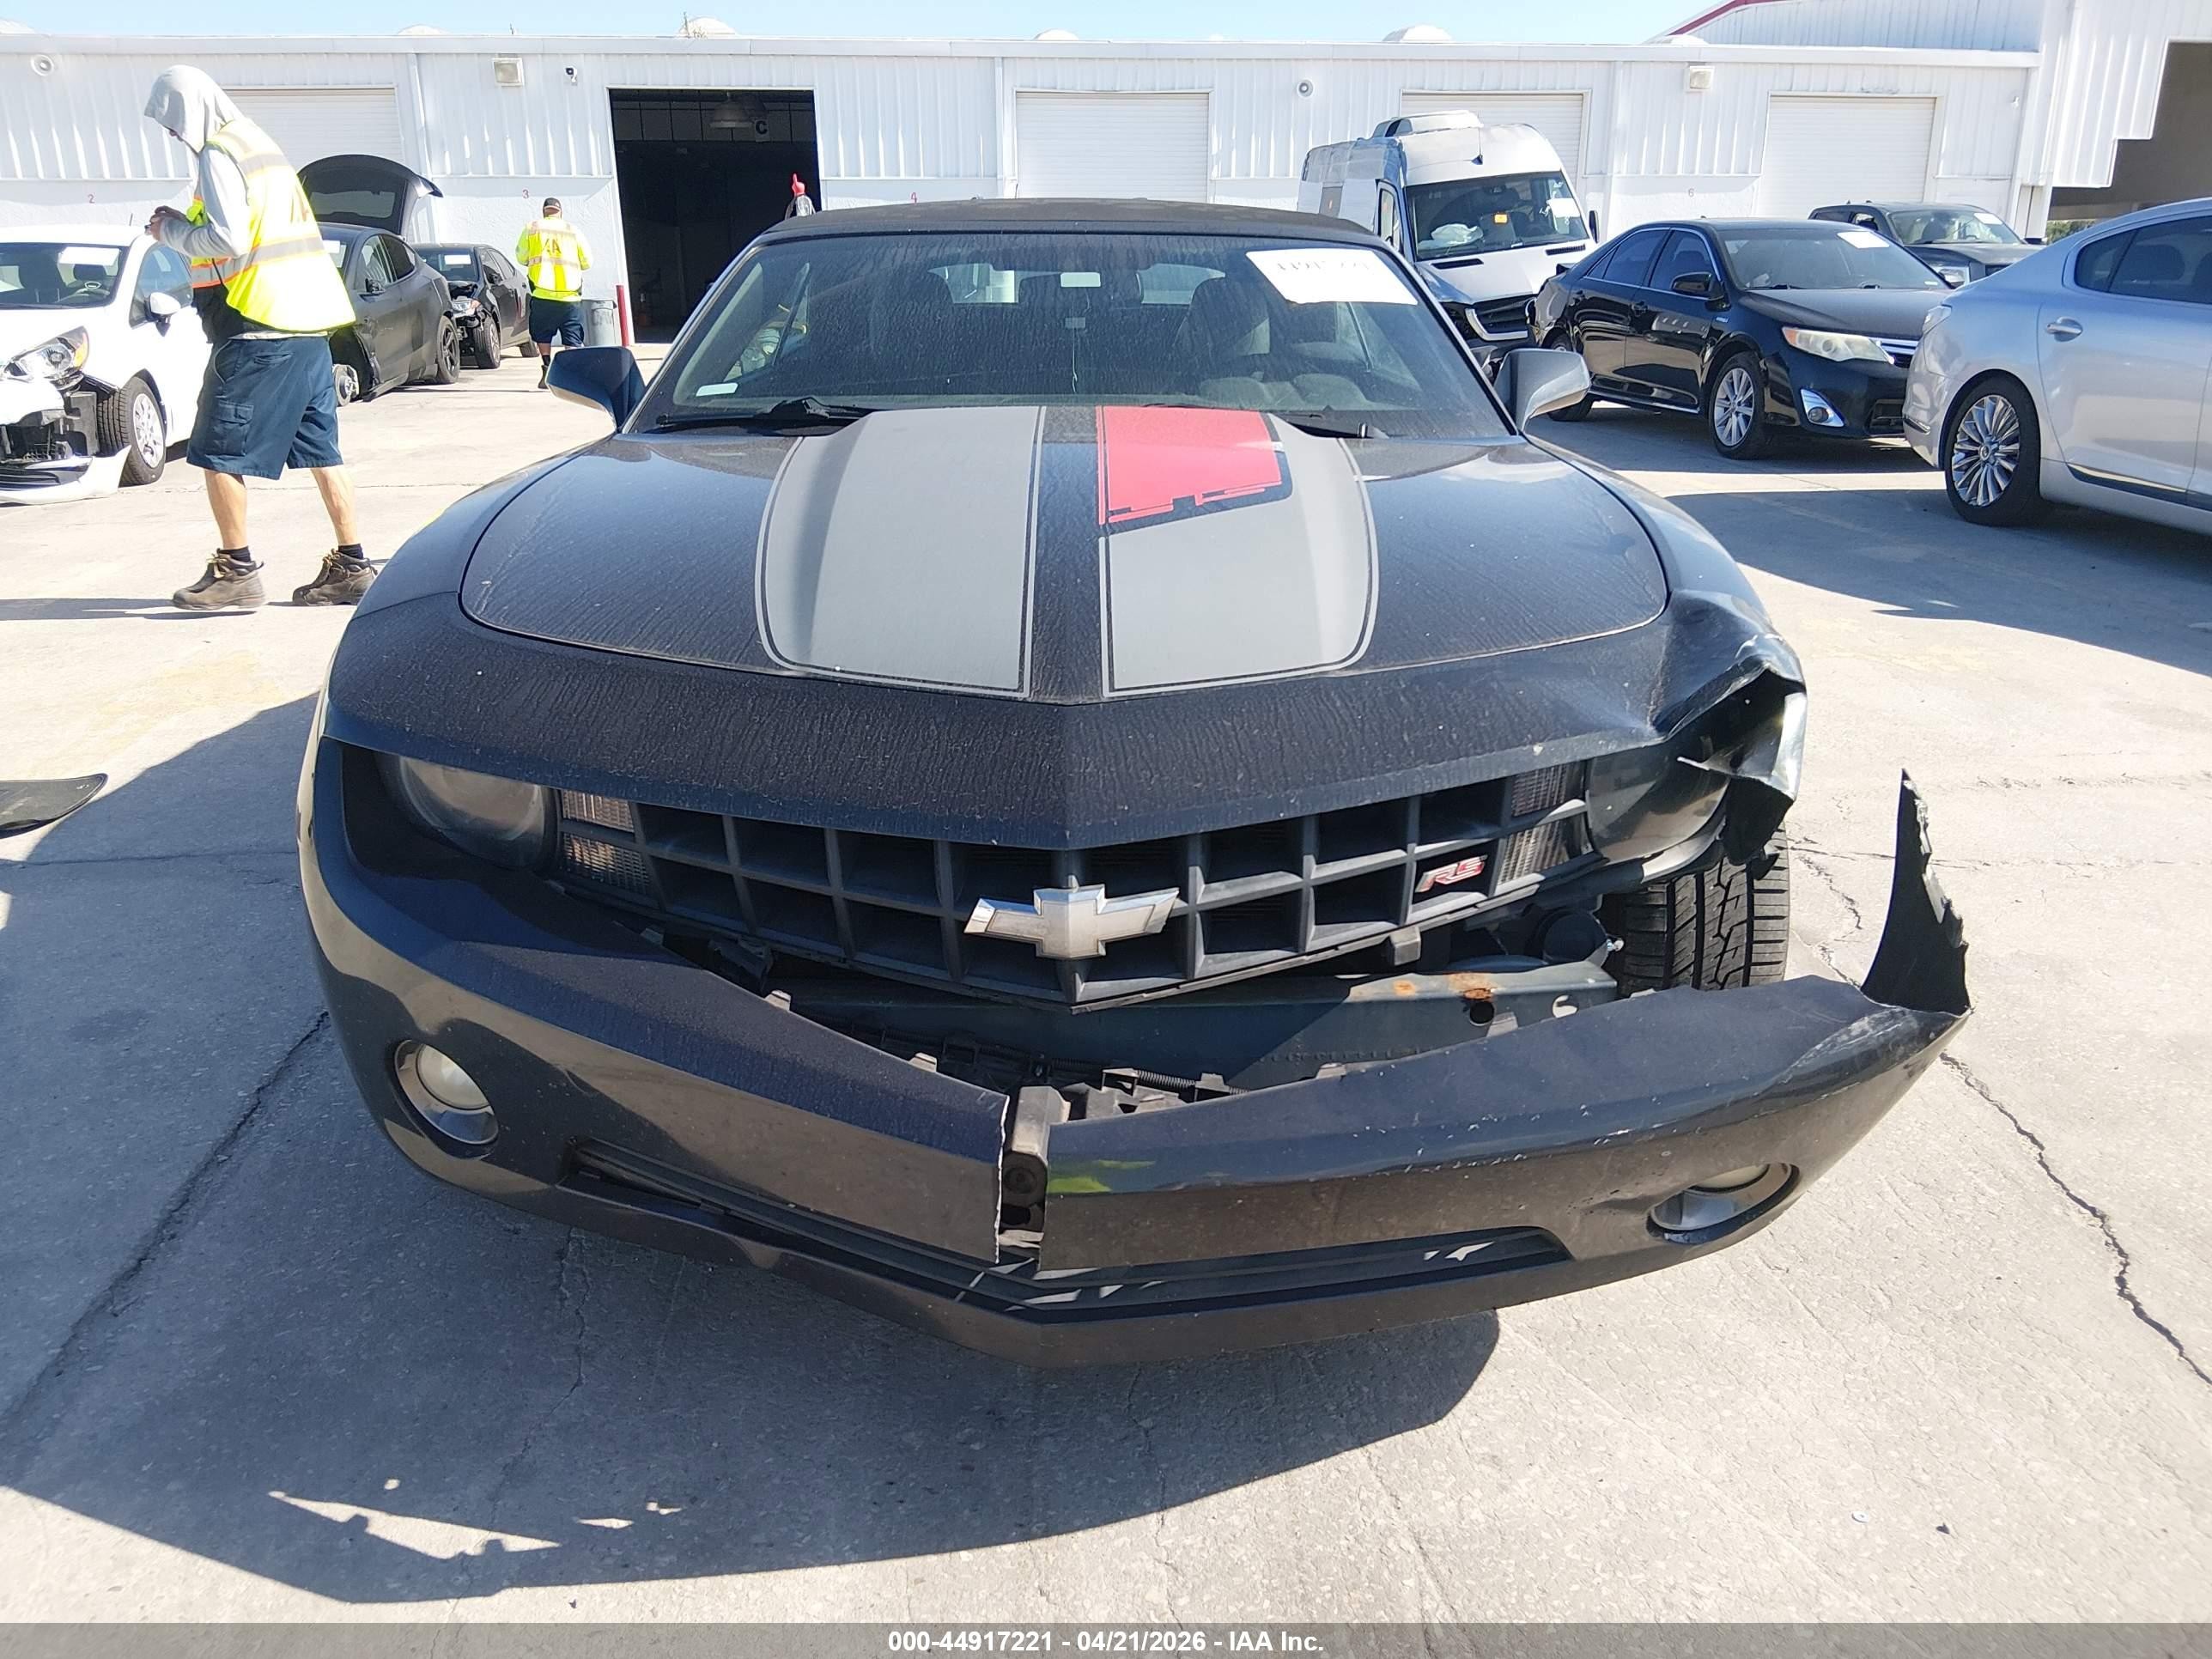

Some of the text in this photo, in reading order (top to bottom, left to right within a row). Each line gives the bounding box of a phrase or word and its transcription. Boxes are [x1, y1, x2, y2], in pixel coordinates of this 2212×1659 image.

[756, 120, 769, 135] C
[521, 189, 530, 199] 3
[1687, 187, 1695, 198] 6
[87, 193, 96, 204] 2
[1414, 854, 1488, 893] RS
